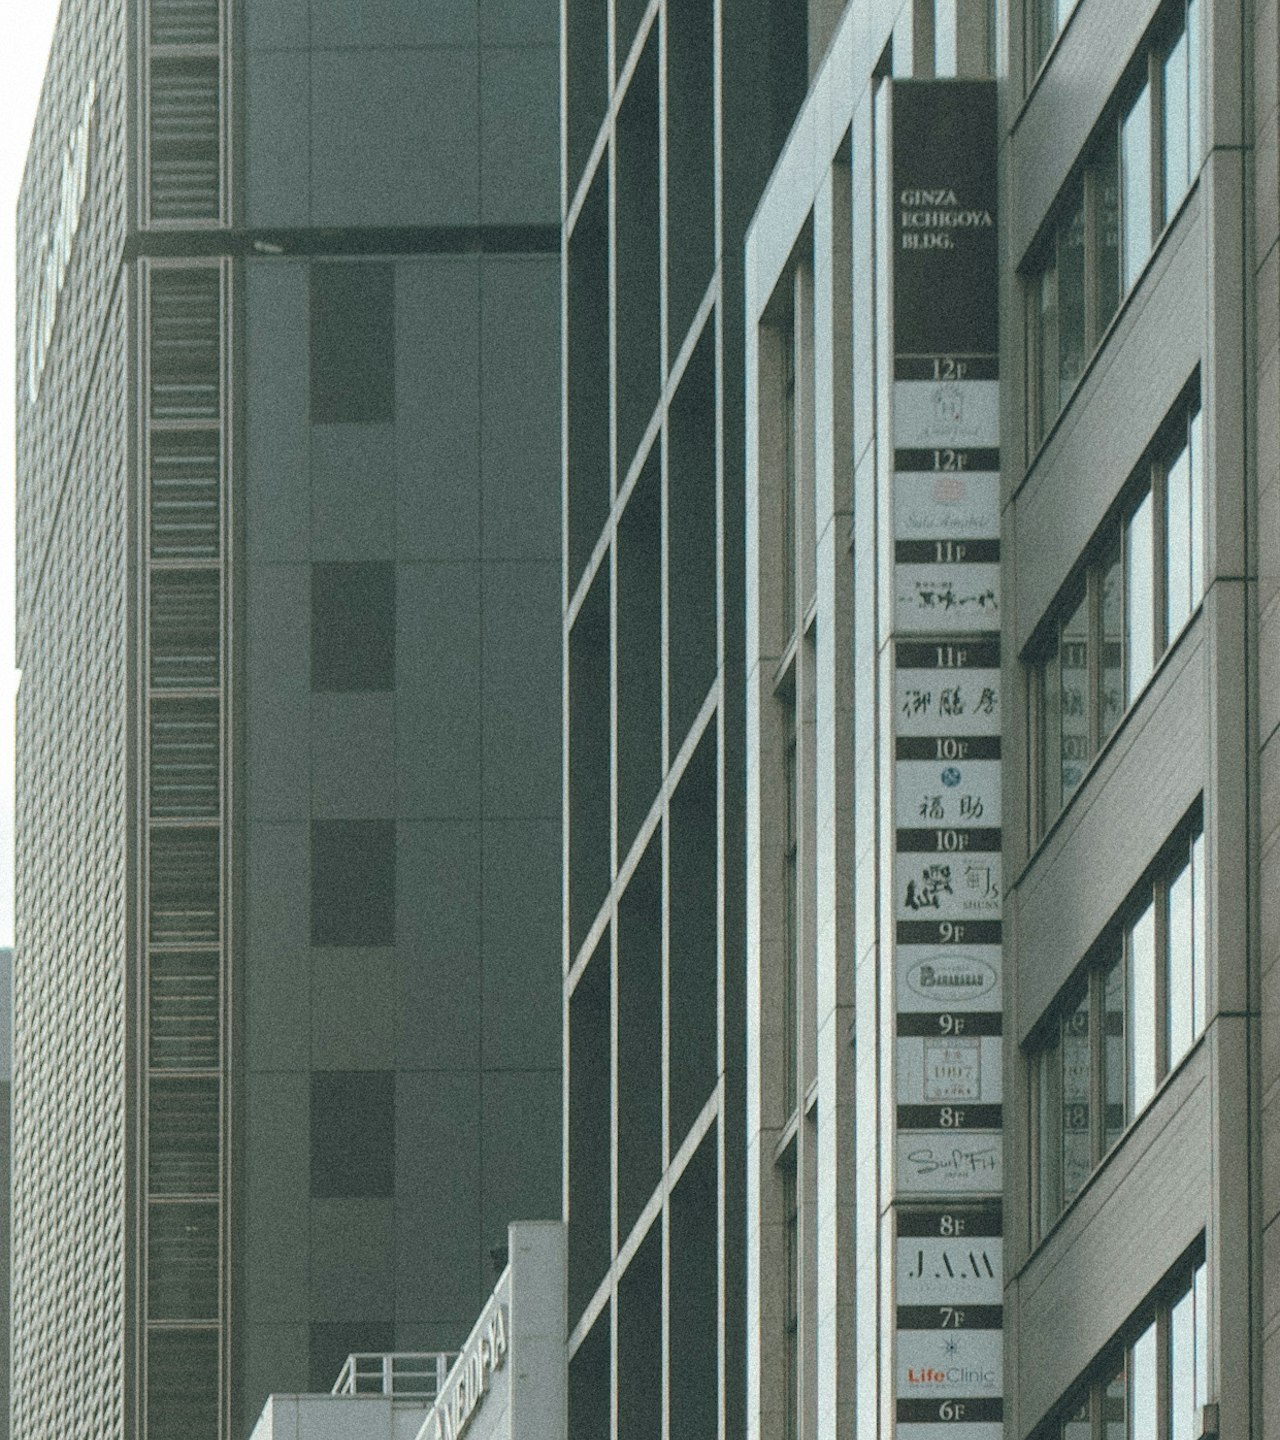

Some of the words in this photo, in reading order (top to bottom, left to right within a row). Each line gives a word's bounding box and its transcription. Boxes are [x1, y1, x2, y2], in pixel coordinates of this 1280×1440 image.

[901, 189, 957, 205] GINZA
[901, 211, 992, 227] ECHIGOYA
[902, 233, 955, 249] BLDG.
[933, 358, 967, 379] 12F
[934, 450, 967, 471] 12F
[937, 541, 966, 562] 11F
[937, 647, 967, 667] 11F
[936, 739, 968, 760] 10F
[919, 795, 984, 819] 福助
[936, 830, 969, 851] 10F
[939, 922, 965, 943] 9F
[939, 1014, 965, 1035] 9F
[940, 1107, 965, 1127] 8F
[940, 1215, 965, 1235] 8F
[940, 1307, 965, 1328] 7F
[939, 1401, 965, 1421] 6F
